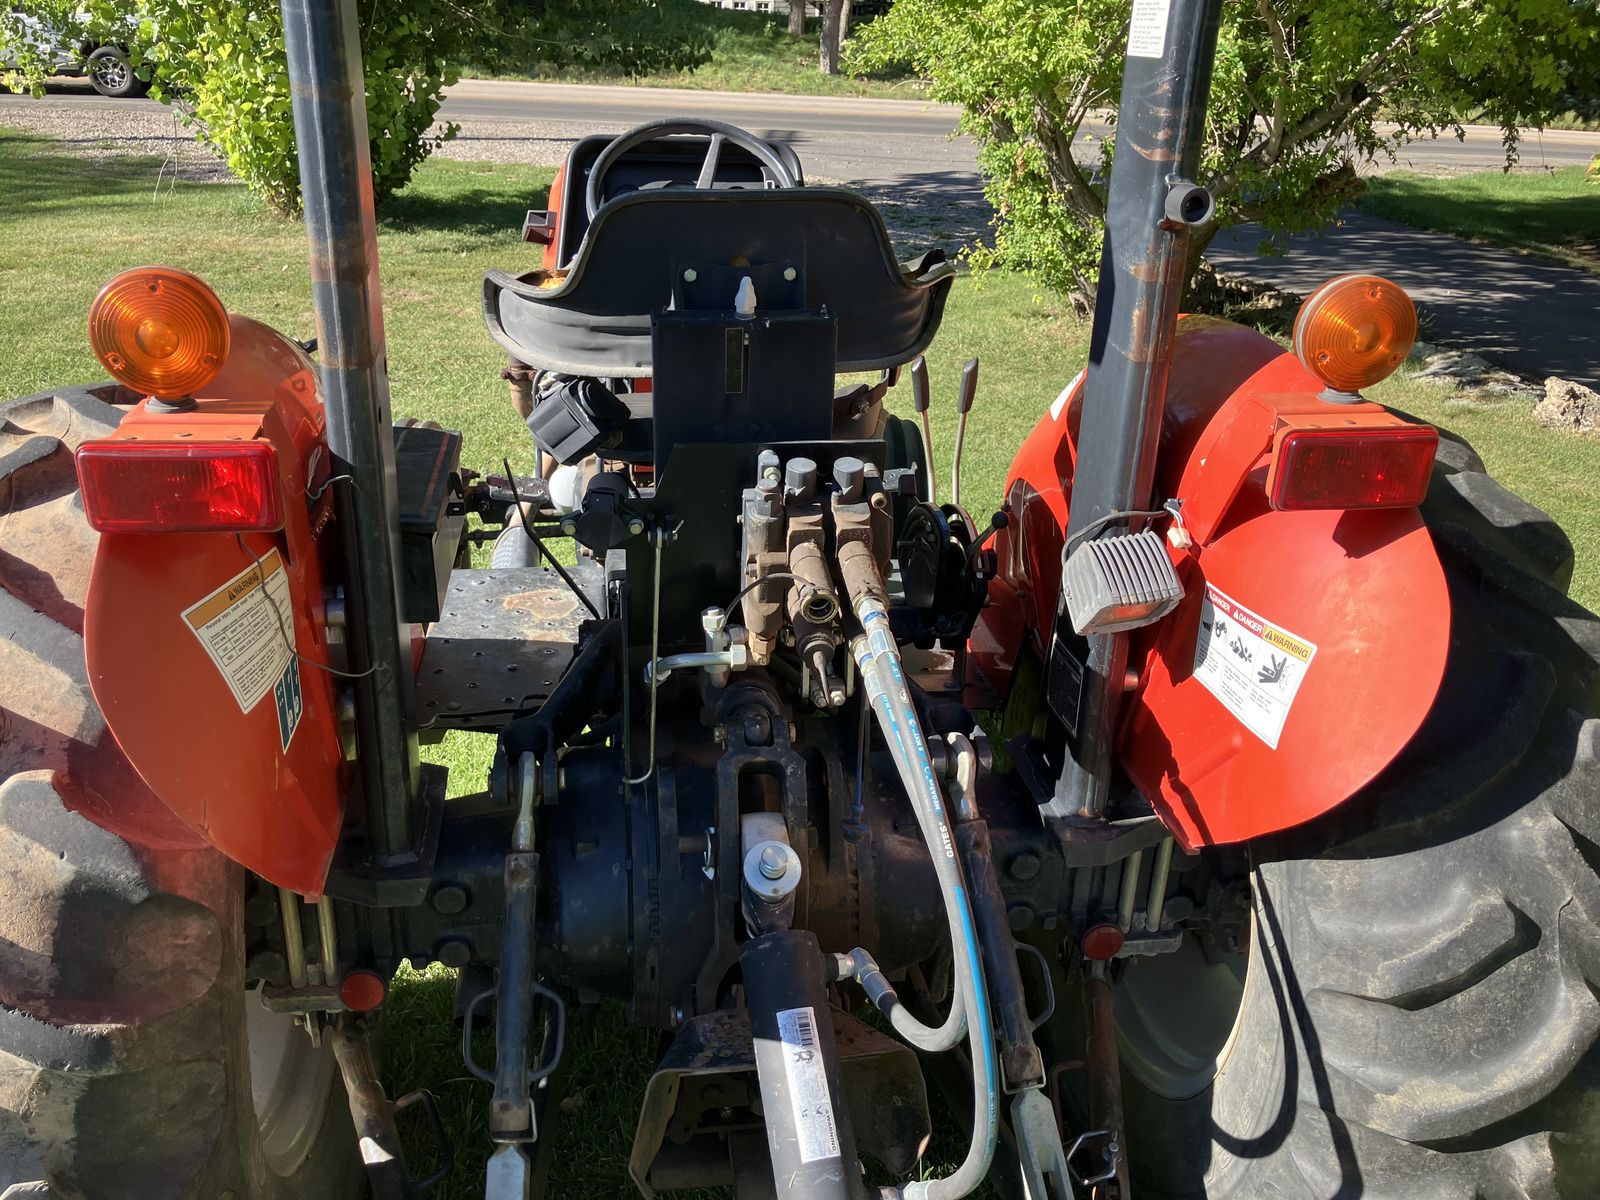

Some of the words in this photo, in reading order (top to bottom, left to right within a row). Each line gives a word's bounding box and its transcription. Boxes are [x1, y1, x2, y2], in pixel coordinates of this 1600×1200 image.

[233, 572, 259, 596] WARNING
[1239, 612, 1263, 633] DANGER
[1273, 634, 1308, 658] WARNING
[826, 1113, 836, 1151] WARNING
